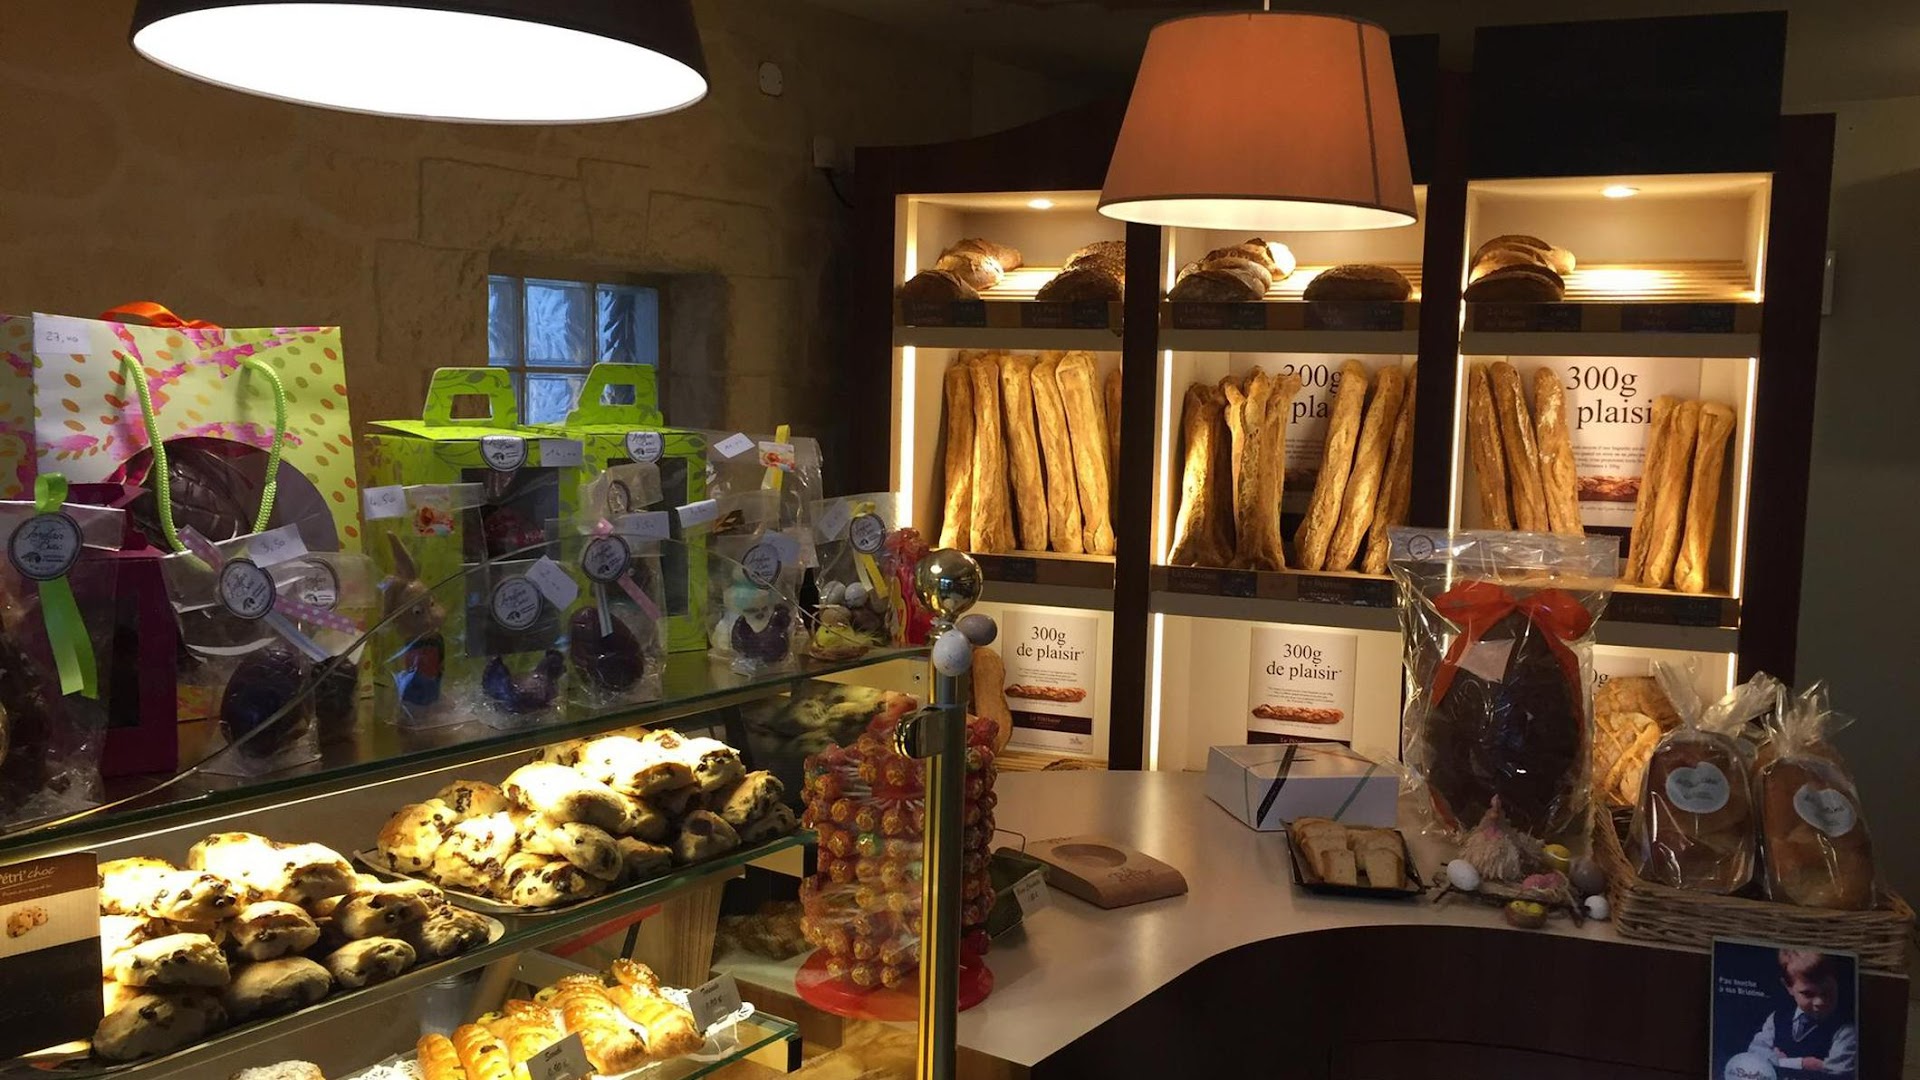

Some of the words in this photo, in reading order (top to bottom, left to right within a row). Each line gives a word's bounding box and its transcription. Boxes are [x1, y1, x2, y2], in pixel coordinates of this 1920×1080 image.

[1566, 366, 1638, 397] 300g
[1291, 395, 1336, 424] pla
[1031, 626, 1066, 646] 300g
[1016, 643, 1033, 657] de
[1283, 643, 1323, 664] 300g
[1266, 661, 1285, 675] de
